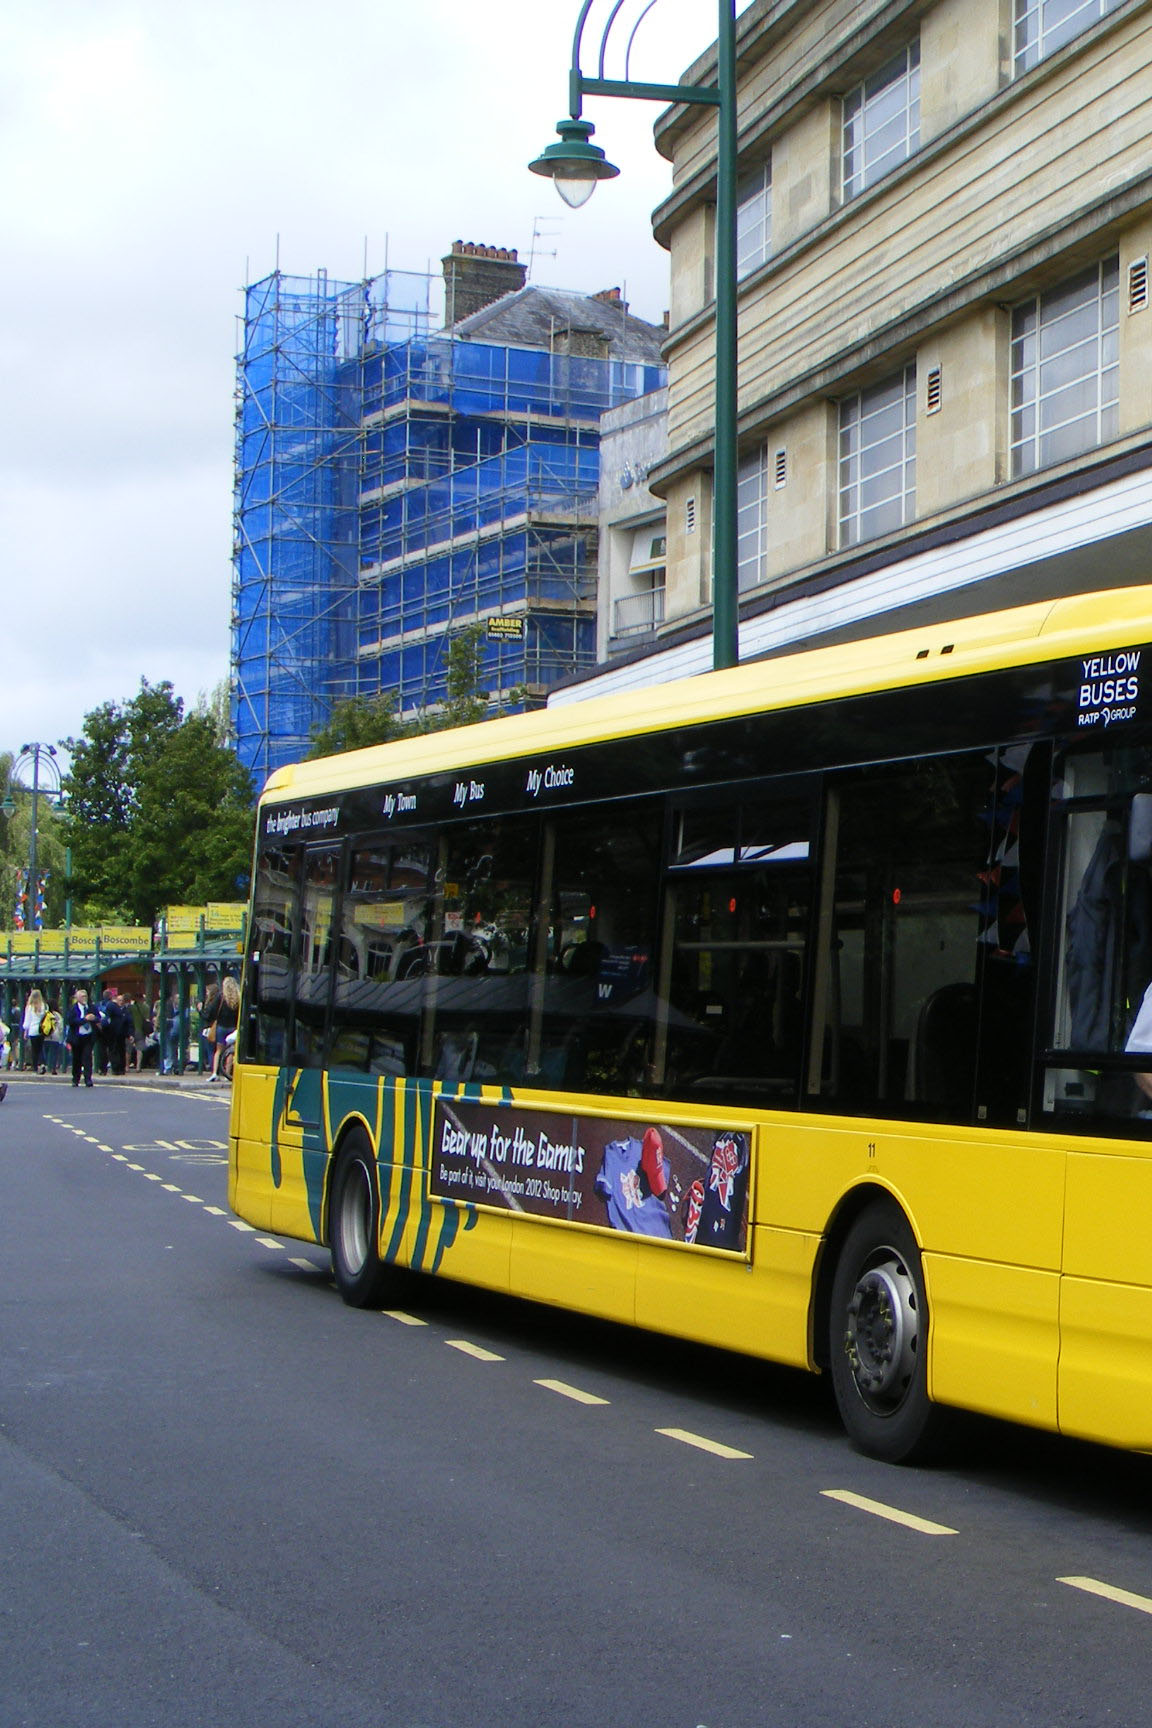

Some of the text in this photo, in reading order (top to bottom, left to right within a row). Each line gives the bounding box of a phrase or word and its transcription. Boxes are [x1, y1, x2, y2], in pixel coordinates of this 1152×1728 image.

[490, 618, 521, 627] AMBER
[1082, 651, 1141, 679] YELLOW
[1079, 676, 1139, 707] BUSES
[1078, 706, 1137, 726] RATP GROUP
[453, 780, 485, 808] My Bus
[526, 764, 575, 796] My Choice
[383, 793, 417, 818] My Town
[266, 807, 340, 835] the brighter bus company
[71, 935, 97, 945] Bosco
[103, 934, 149, 945] Boscombe
[442, 1119, 586, 1174] Gear up for the Games
[867, 1143, 876, 1158] 11
[439, 1163, 448, 1181] Be
[448, 1168, 461, 1187] part
[461, 1165, 469, 1185] of
[475, 1170, 487, 1189] visit
[502, 1174, 525, 1196] London
[525, 1177, 541, 1197] 2012
[543, 1180, 561, 1206] Shop
